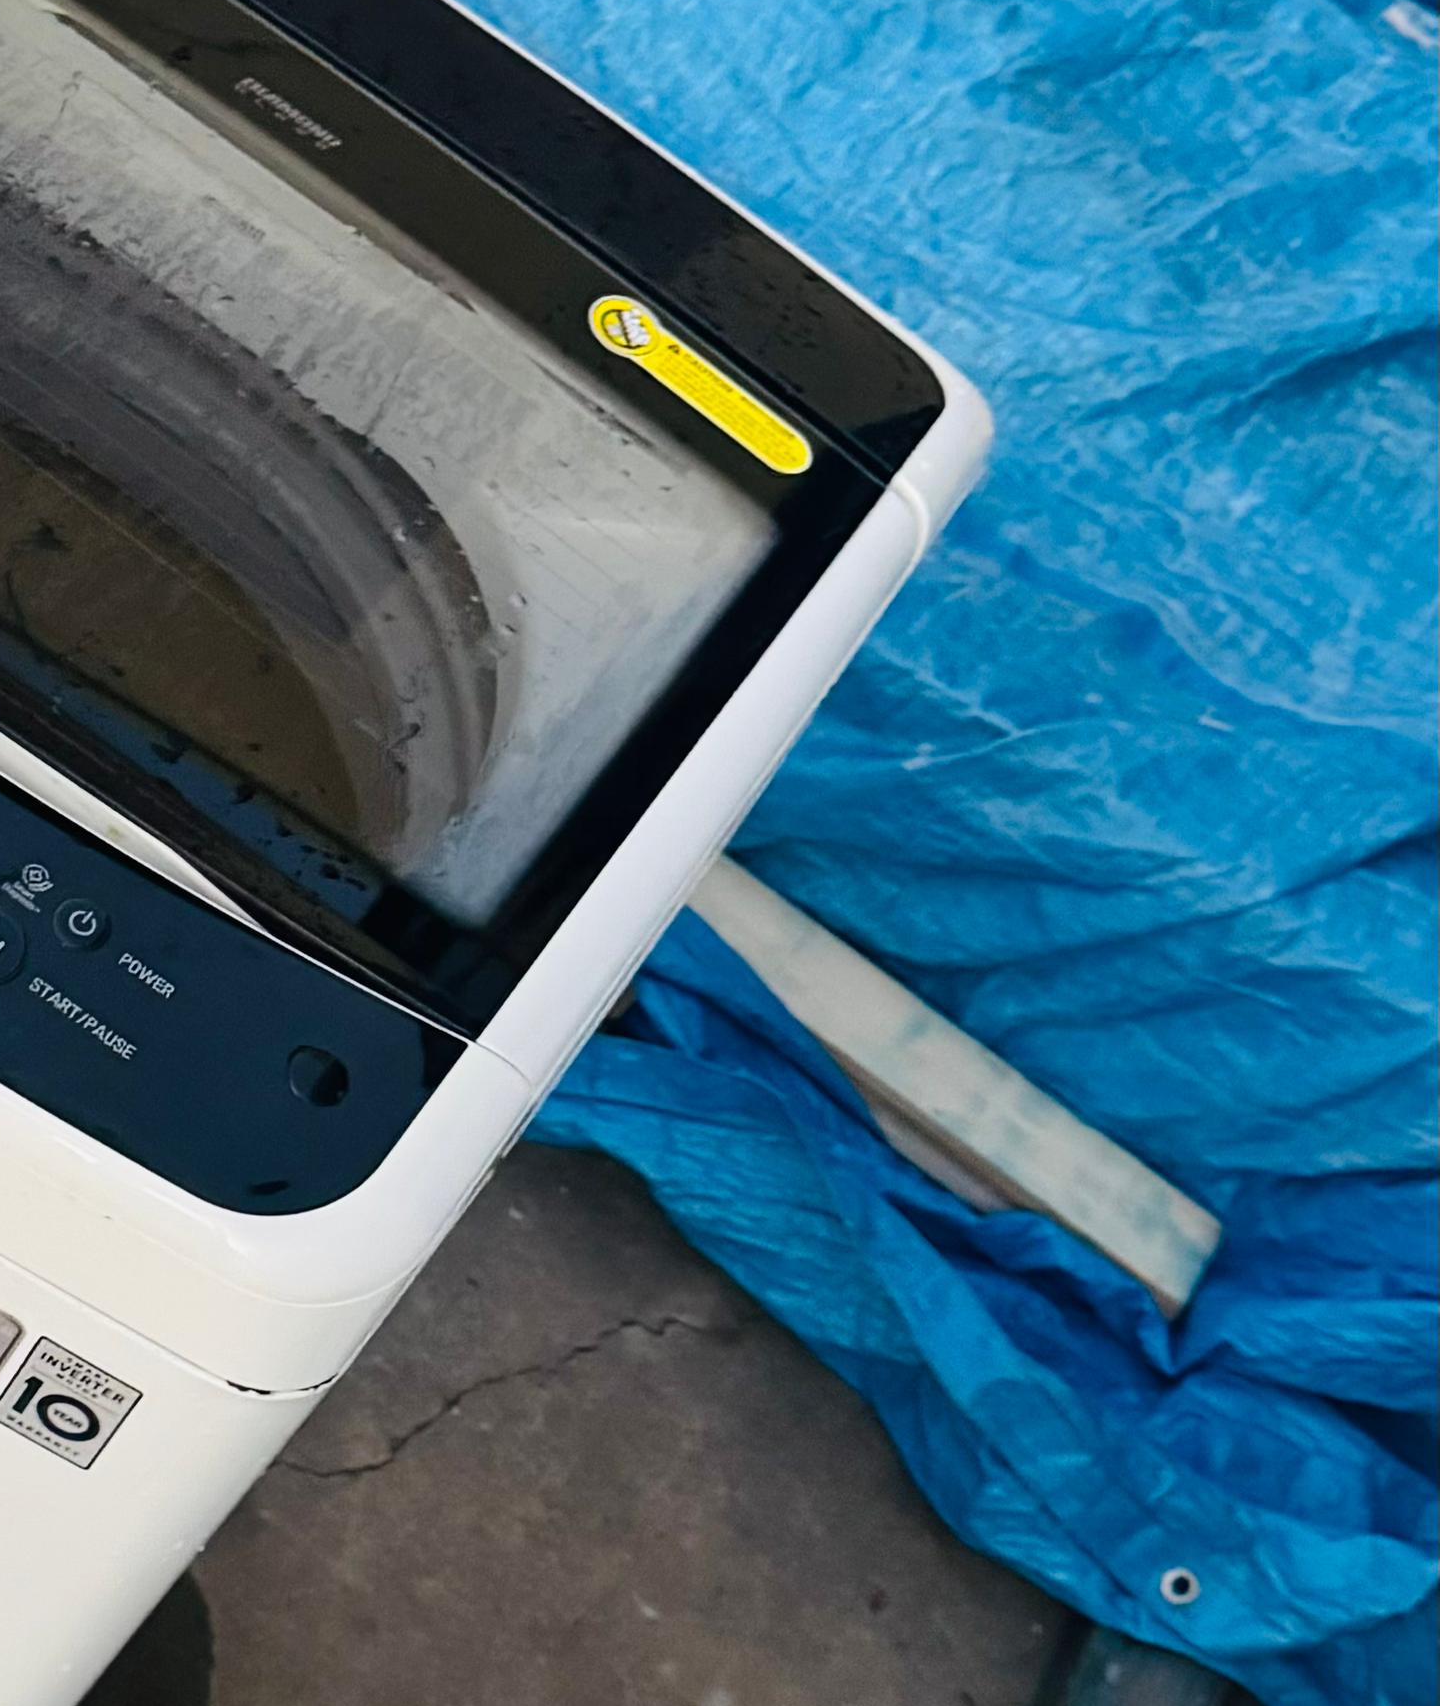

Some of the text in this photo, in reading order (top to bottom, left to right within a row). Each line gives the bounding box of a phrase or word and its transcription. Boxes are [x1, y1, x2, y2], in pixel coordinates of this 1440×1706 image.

[117, 951, 177, 999] POWER
[27, 975, 138, 1061] START/PAUSE
[40, 1351, 125, 1404] INVERTER
[11, 1373, 105, 1454] 10 YEAR
